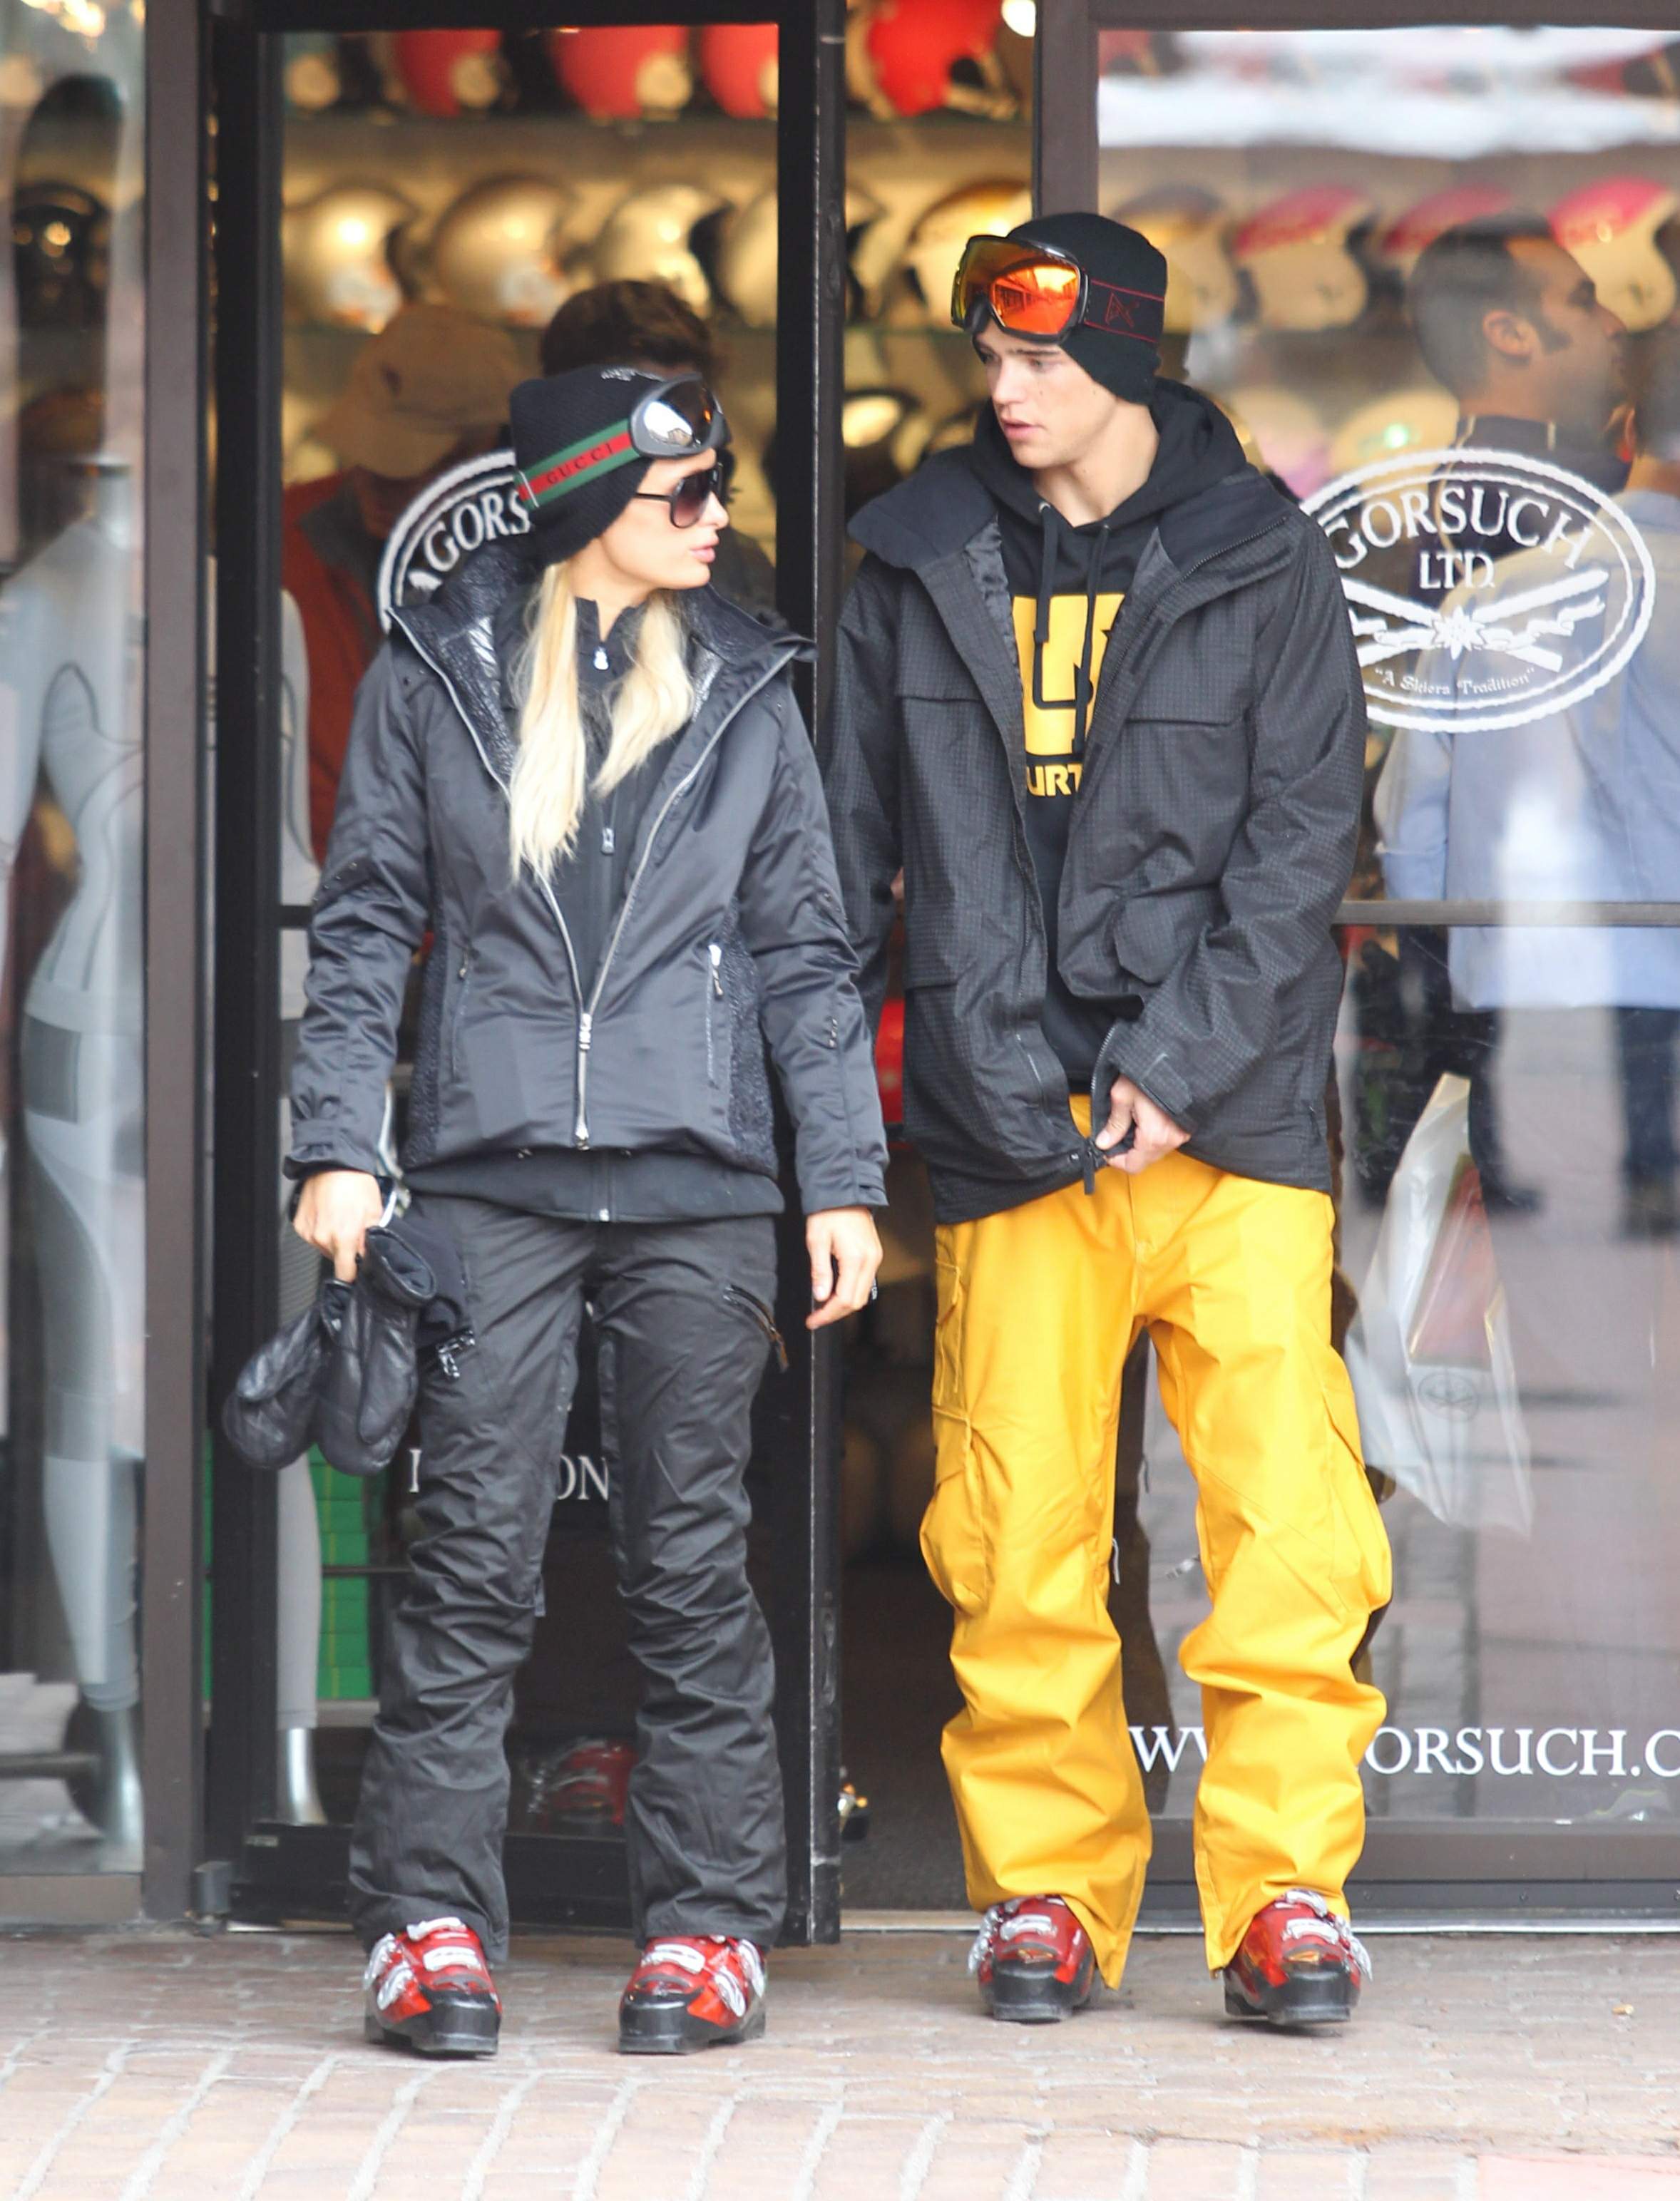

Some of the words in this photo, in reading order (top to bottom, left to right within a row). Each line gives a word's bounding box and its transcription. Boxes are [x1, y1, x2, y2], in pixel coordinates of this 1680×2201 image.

[547, 442, 613, 484] GUCCI
[424, 489, 531, 572] GORS
[1323, 486, 1595, 570] GORSUCH
[1026, 764, 1082, 796] URT
